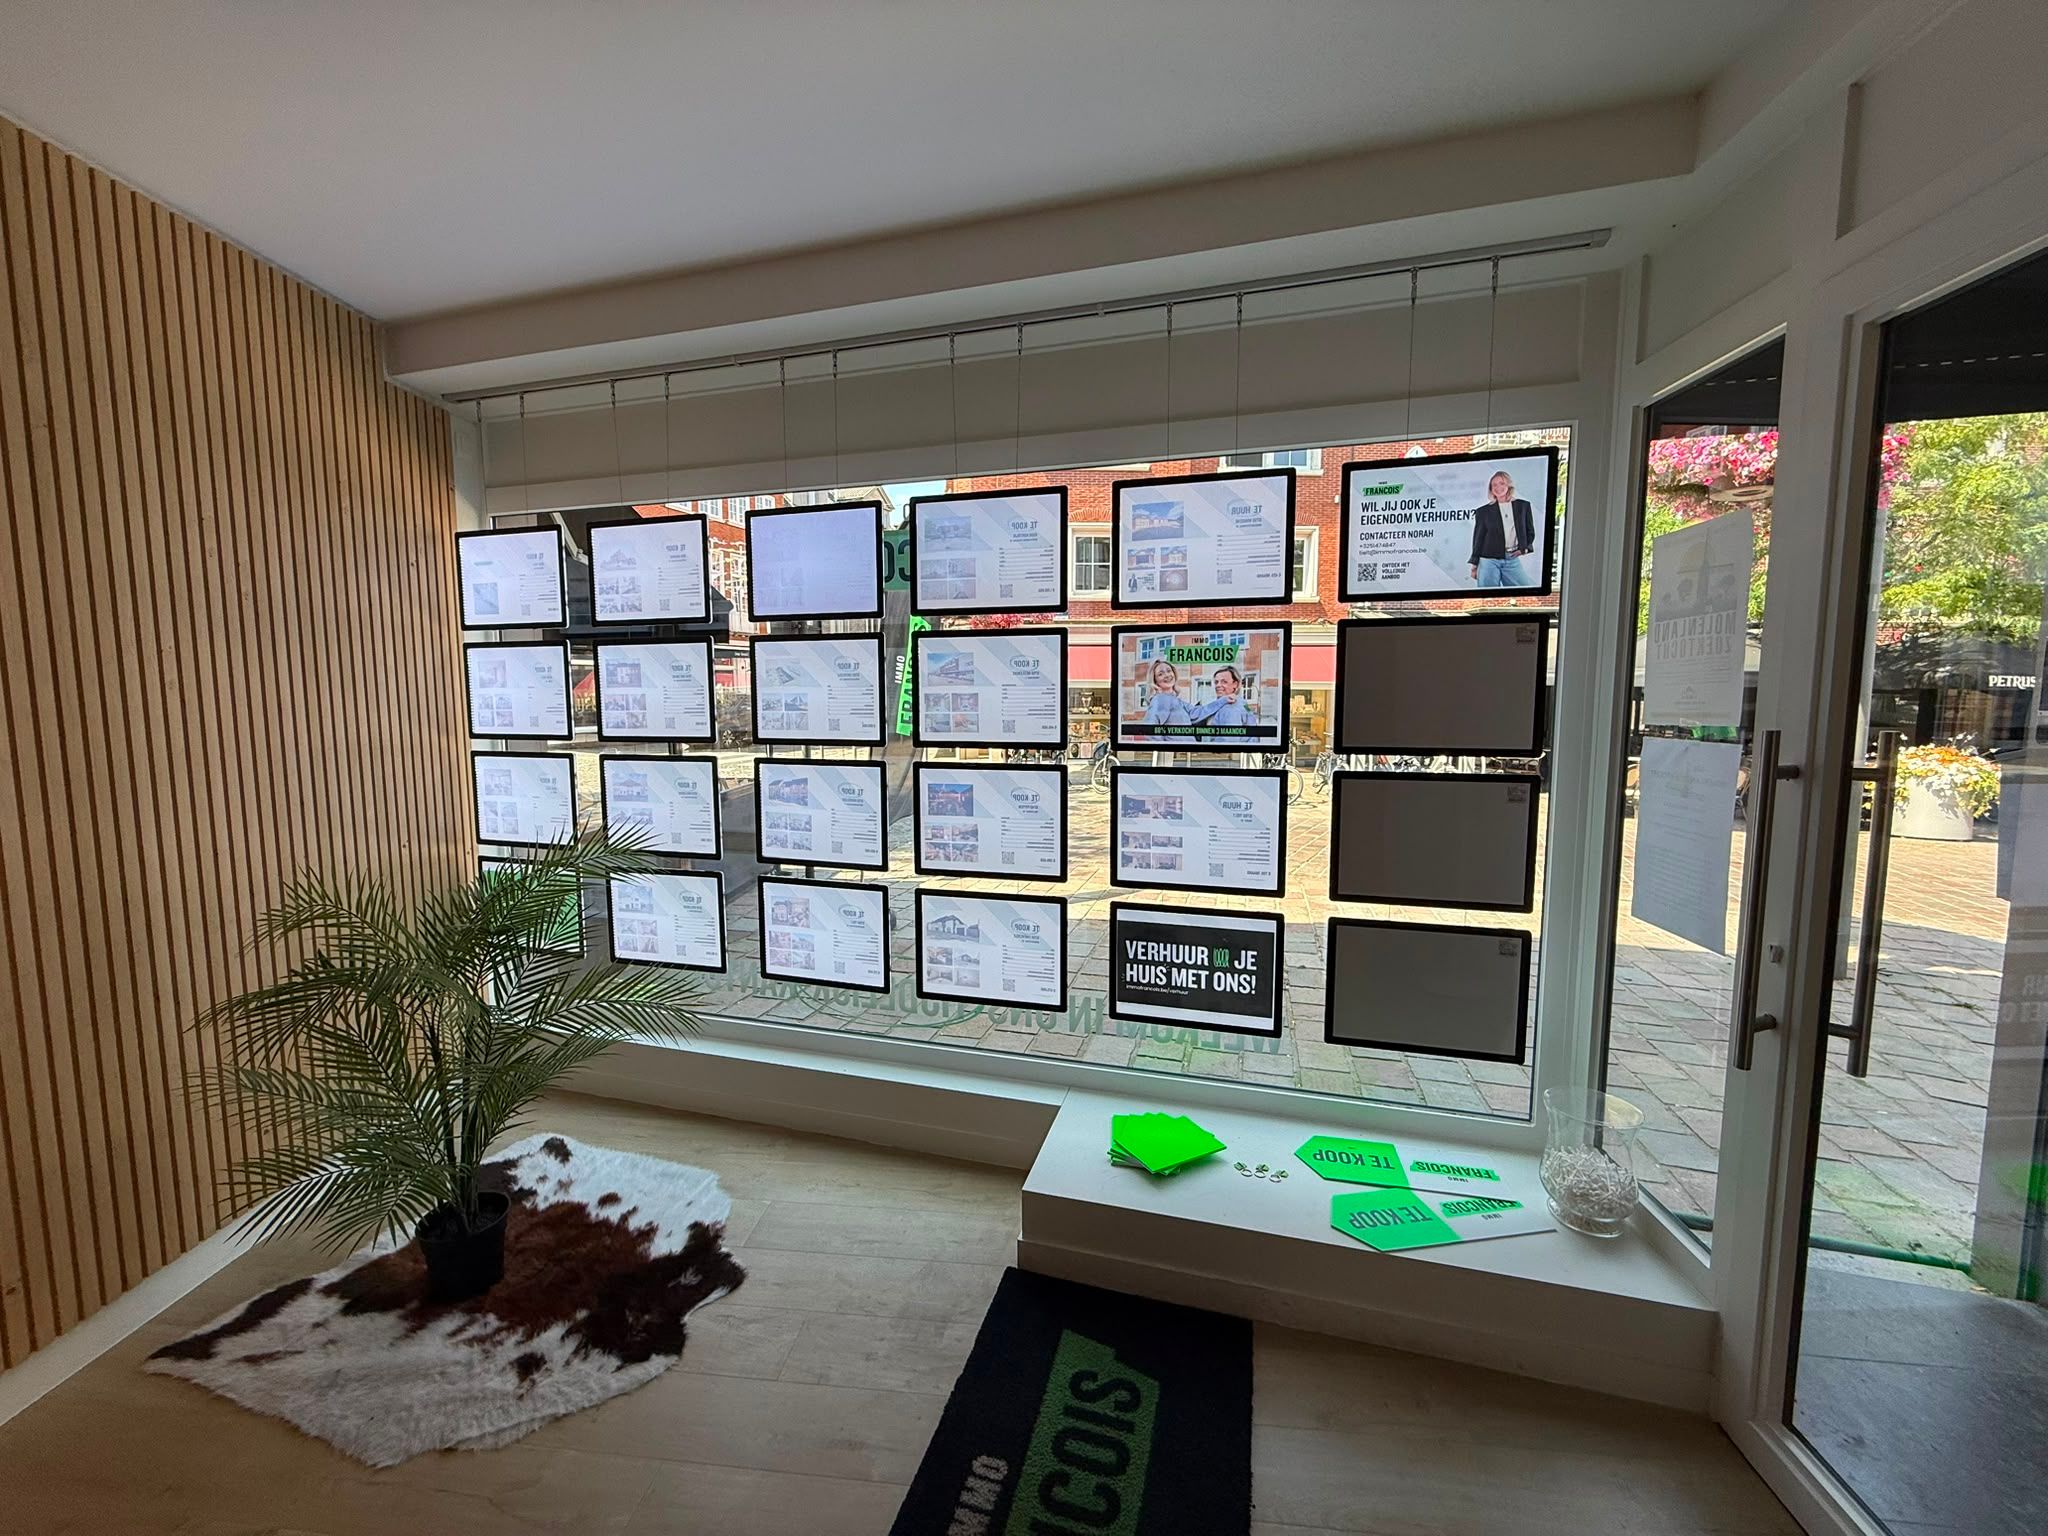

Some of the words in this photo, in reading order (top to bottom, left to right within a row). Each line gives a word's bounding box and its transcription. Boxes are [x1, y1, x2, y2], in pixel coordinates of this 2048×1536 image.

[1365, 486, 1400, 496] FRANCOIS
[1361, 502, 1379, 512] WIL
[1381, 500, 1397, 511] JIJ
[1400, 499, 1421, 510] OOK
[1423, 498, 1436, 509] JE
[1360, 512, 1412, 525] EIGENDOM
[1415, 509, 1476, 523] VERHUREN?
[1360, 531, 1406, 541] CONTACTEER
[1408, 529, 1434, 538] NORAH
[1169, 648, 1234, 662] FRANCOIS
[894, 655, 906, 684] IMMO
[1125, 940, 1209, 967] VERHUUR
[1234, 950, 1258, 971] JE
[1125, 963, 1167, 986] HUIS
[1171, 967, 1209, 990] MET
[1212, 972, 1257, 995] ONS!
[1312, 1148, 1366, 1166] KOOP
[1368, 1154, 1396, 1169] TE
[1415, 1161, 1493, 1179] FRANCOIS
[1349, 1208, 1406, 1229] KOOP
[1398, 1205, 1433, 1223] TE
